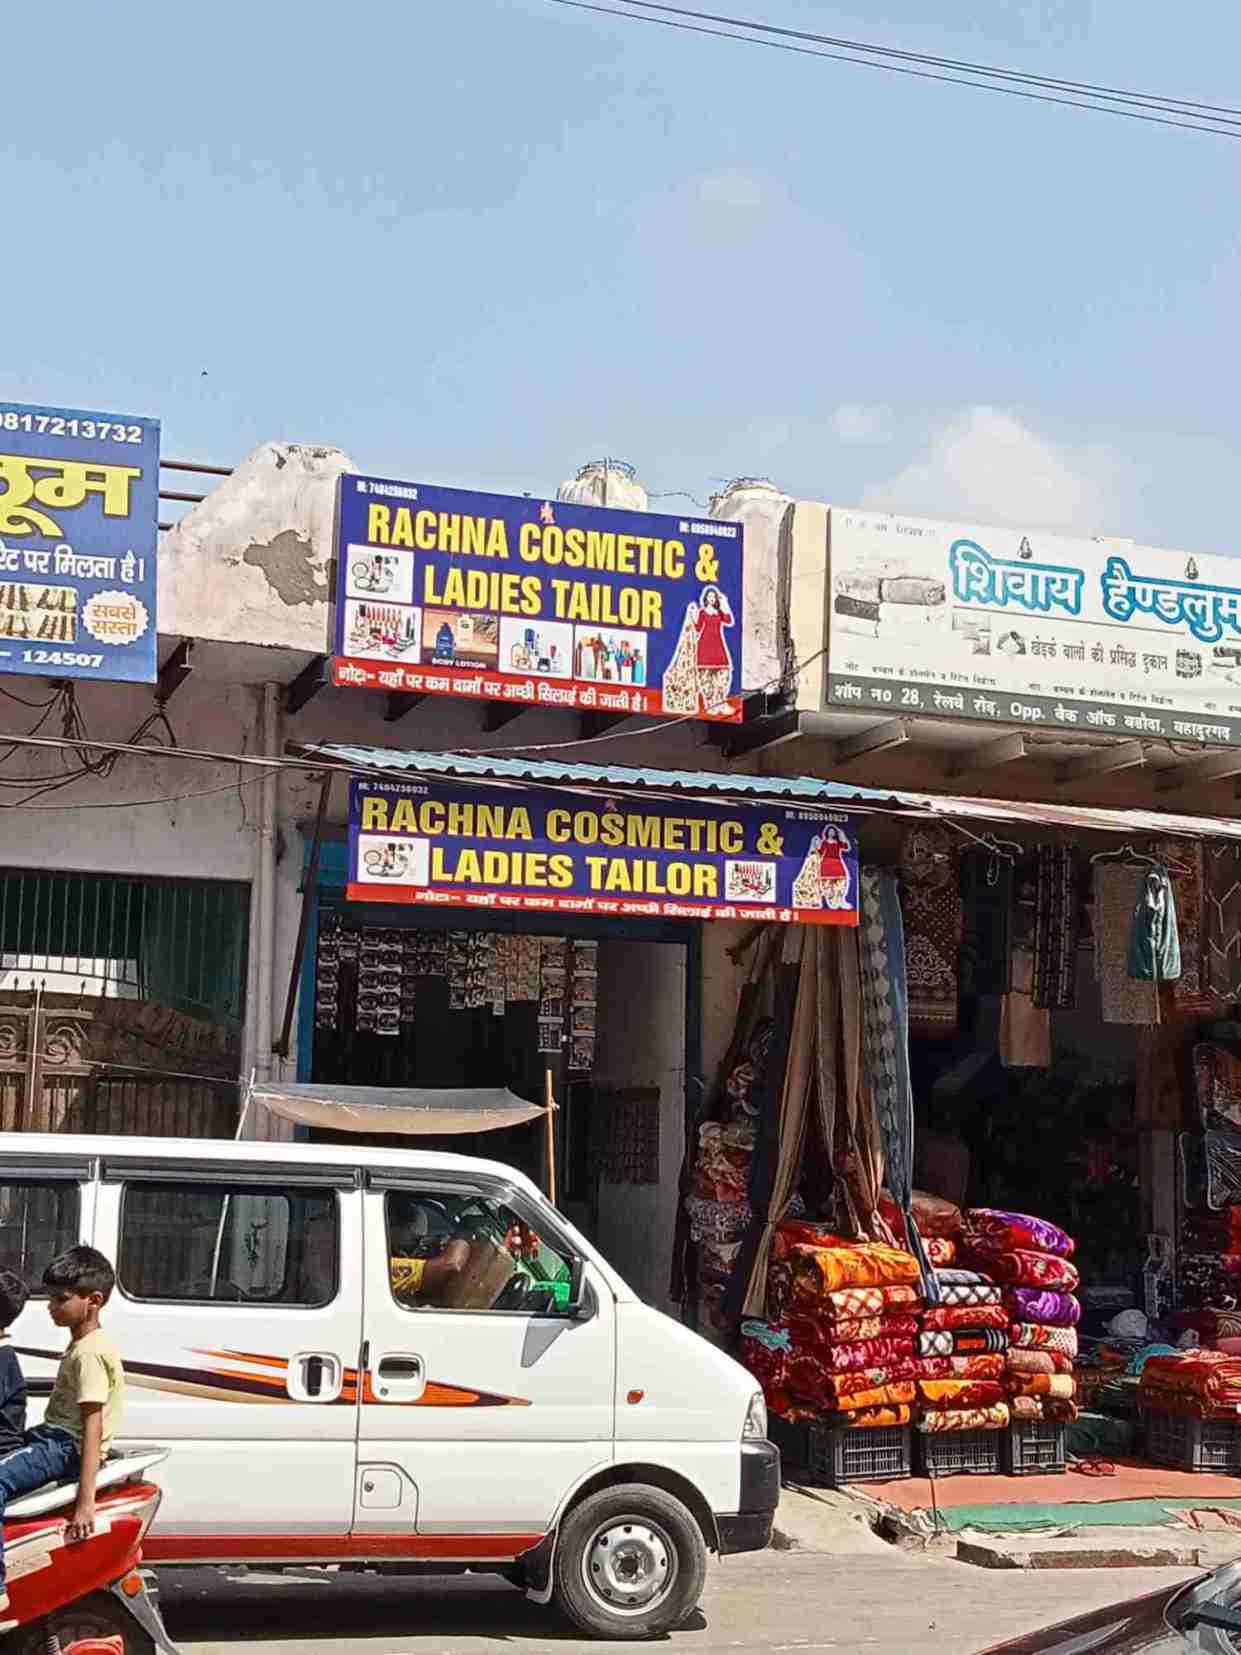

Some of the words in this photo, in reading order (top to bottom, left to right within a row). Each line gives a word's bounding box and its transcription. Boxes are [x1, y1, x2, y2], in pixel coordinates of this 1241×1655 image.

[0, 412, 142, 443] 817213732
[368, 502, 509, 558] RACHNA
[519, 522, 686, 578] COSMETIC
[695, 543, 719, 582] &
[24, 550, 50, 574] पर
[55, 544, 116, 579] मिलता
[949, 539, 1084, 615] शिवाय
[92, 602, 136, 620] सबसे
[424, 564, 542, 615] LADIES
[552, 579, 662, 629] TAILOR
[92, 621, 137, 635] सस्ता
[23, 649, 104, 668] 124507
[1142, 653, 1168, 674] दुकान
[406, 674, 423, 689] पर
[425, 677, 449, 692] कम
[484, 681, 501, 696] पर
[580, 687, 597, 706] की
[600, 690, 630, 709] जाती
[933, 690, 964, 711] रेलवे
[361, 796, 533, 840] RACHNA
[546, 809, 744, 854] COSMETIC
[756, 822, 784, 857] &
[431, 847, 573, 889] LADIES
[585, 856, 718, 897] TAILOR
[500, 896, 521, 907] पर
[597, 901, 618, 912] पर
